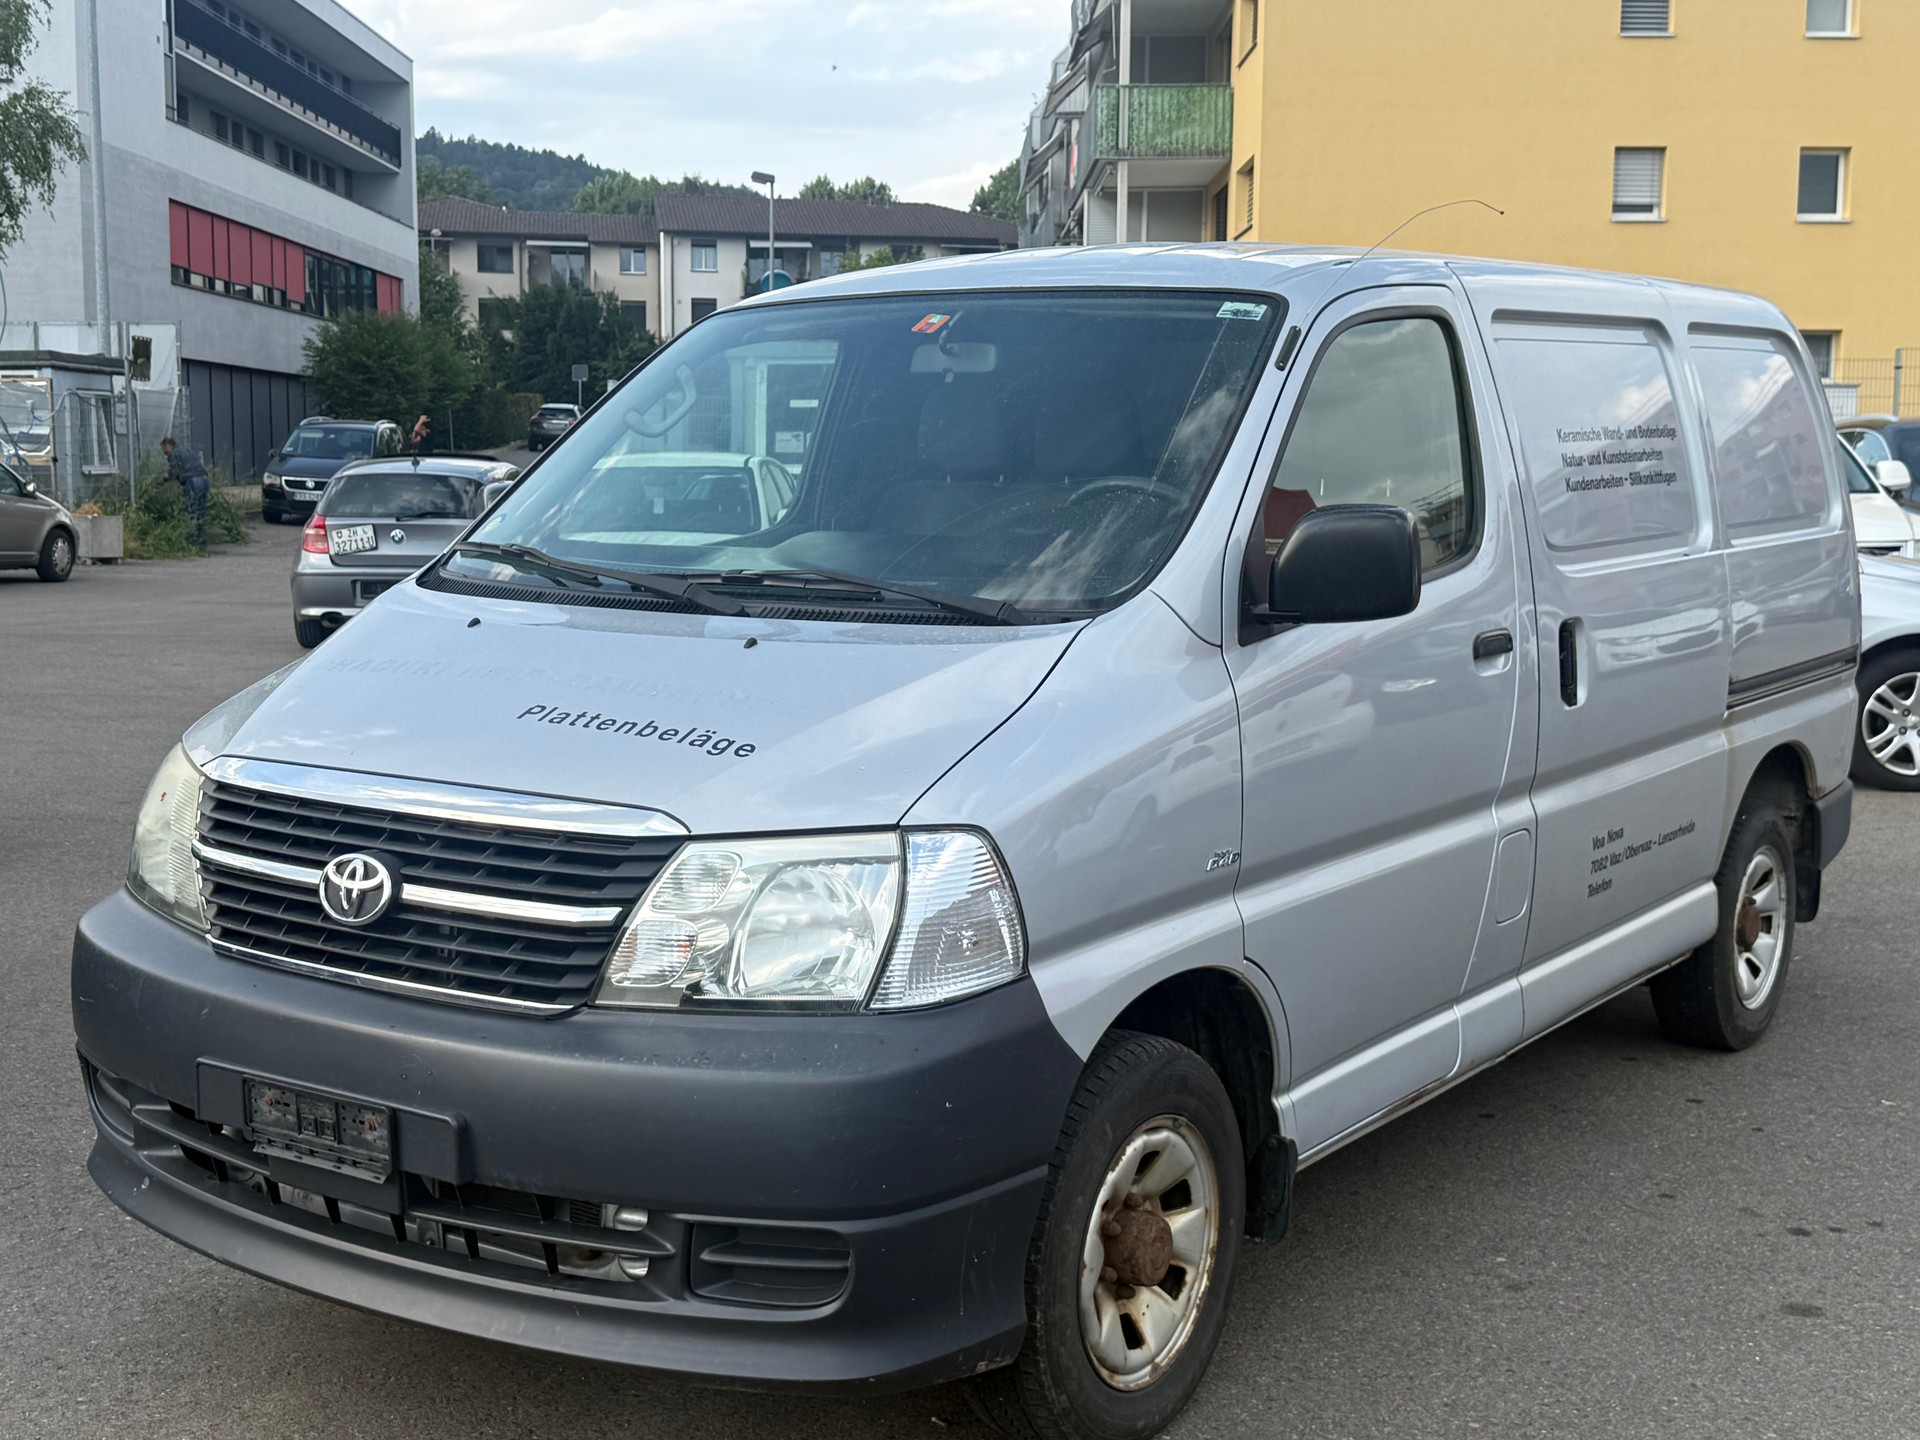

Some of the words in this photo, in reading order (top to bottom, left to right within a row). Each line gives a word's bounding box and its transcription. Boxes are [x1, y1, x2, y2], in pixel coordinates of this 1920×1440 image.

[1556, 427, 1602, 443] Keramische
[1601, 425, 1624, 440] Wand-
[1625, 425, 1638, 440] und
[1561, 451, 1586, 468] Natur-
[1587, 450, 1602, 466] und
[1601, 447, 1664, 464] Kunststeinarbeiten
[1565, 474, 1624, 492] Kundenarbeiten
[348, 527, 359, 538] ZH
[516, 703, 757, 758] Plattenbeläge
[1590, 854, 1609, 875] 7082
[1657, 818, 1696, 846] Lenzerheide
[1592, 835, 1606, 851] Voa
[1606, 827, 1624, 845] Nova
[1587, 878, 1612, 898] Telefon
